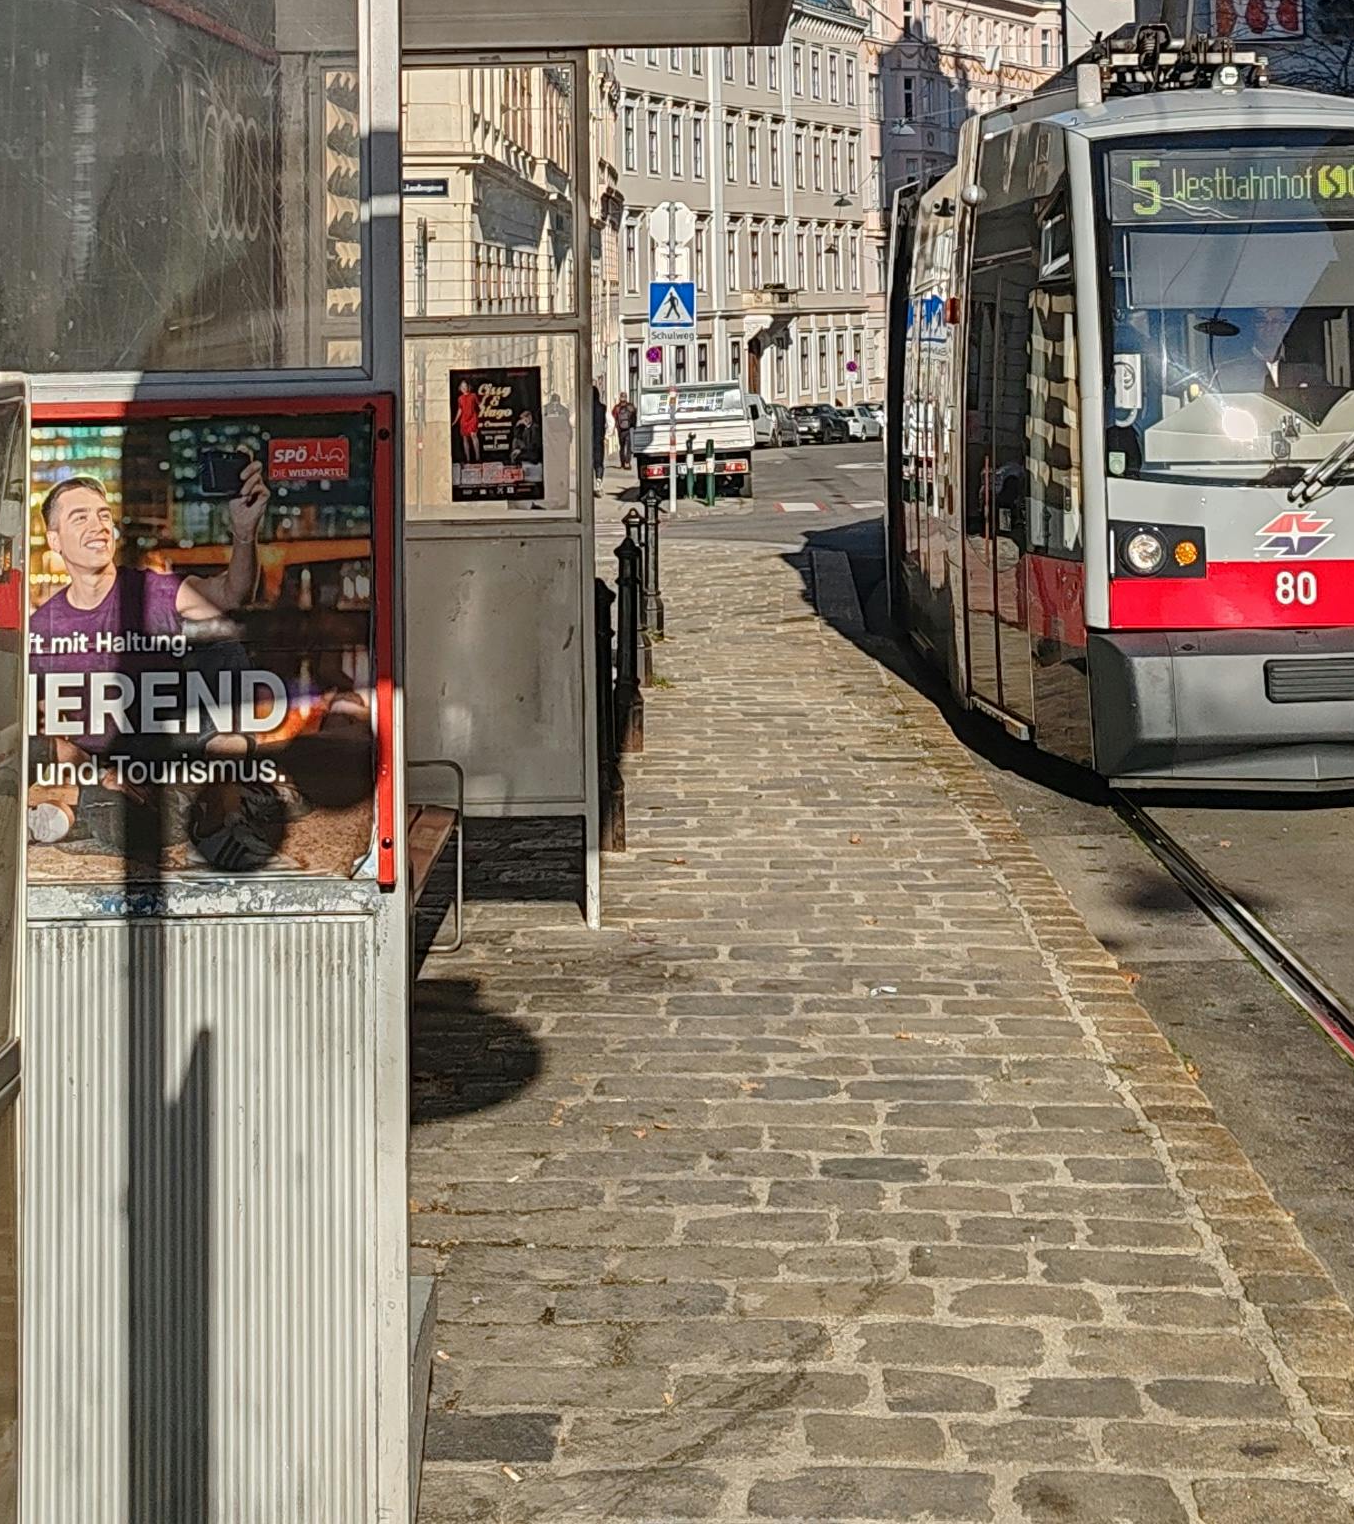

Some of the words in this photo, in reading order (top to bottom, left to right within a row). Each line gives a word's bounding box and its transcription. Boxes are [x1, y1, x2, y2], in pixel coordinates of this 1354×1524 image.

[1131, 159, 1162, 215] 5
[1172, 166, 1313, 201] Westbahnhof
[651, 331, 695, 343] Schulweg
[273, 445, 308, 463] SPÖ
[272, 469, 287, 478] DIE
[1275, 570, 1317, 605] 80
[50, 631, 89, 654] mit
[96, 630, 193, 657] Haltung.
[36, 755, 99, 786] und
[110, 754, 286, 785] Tourismus.
